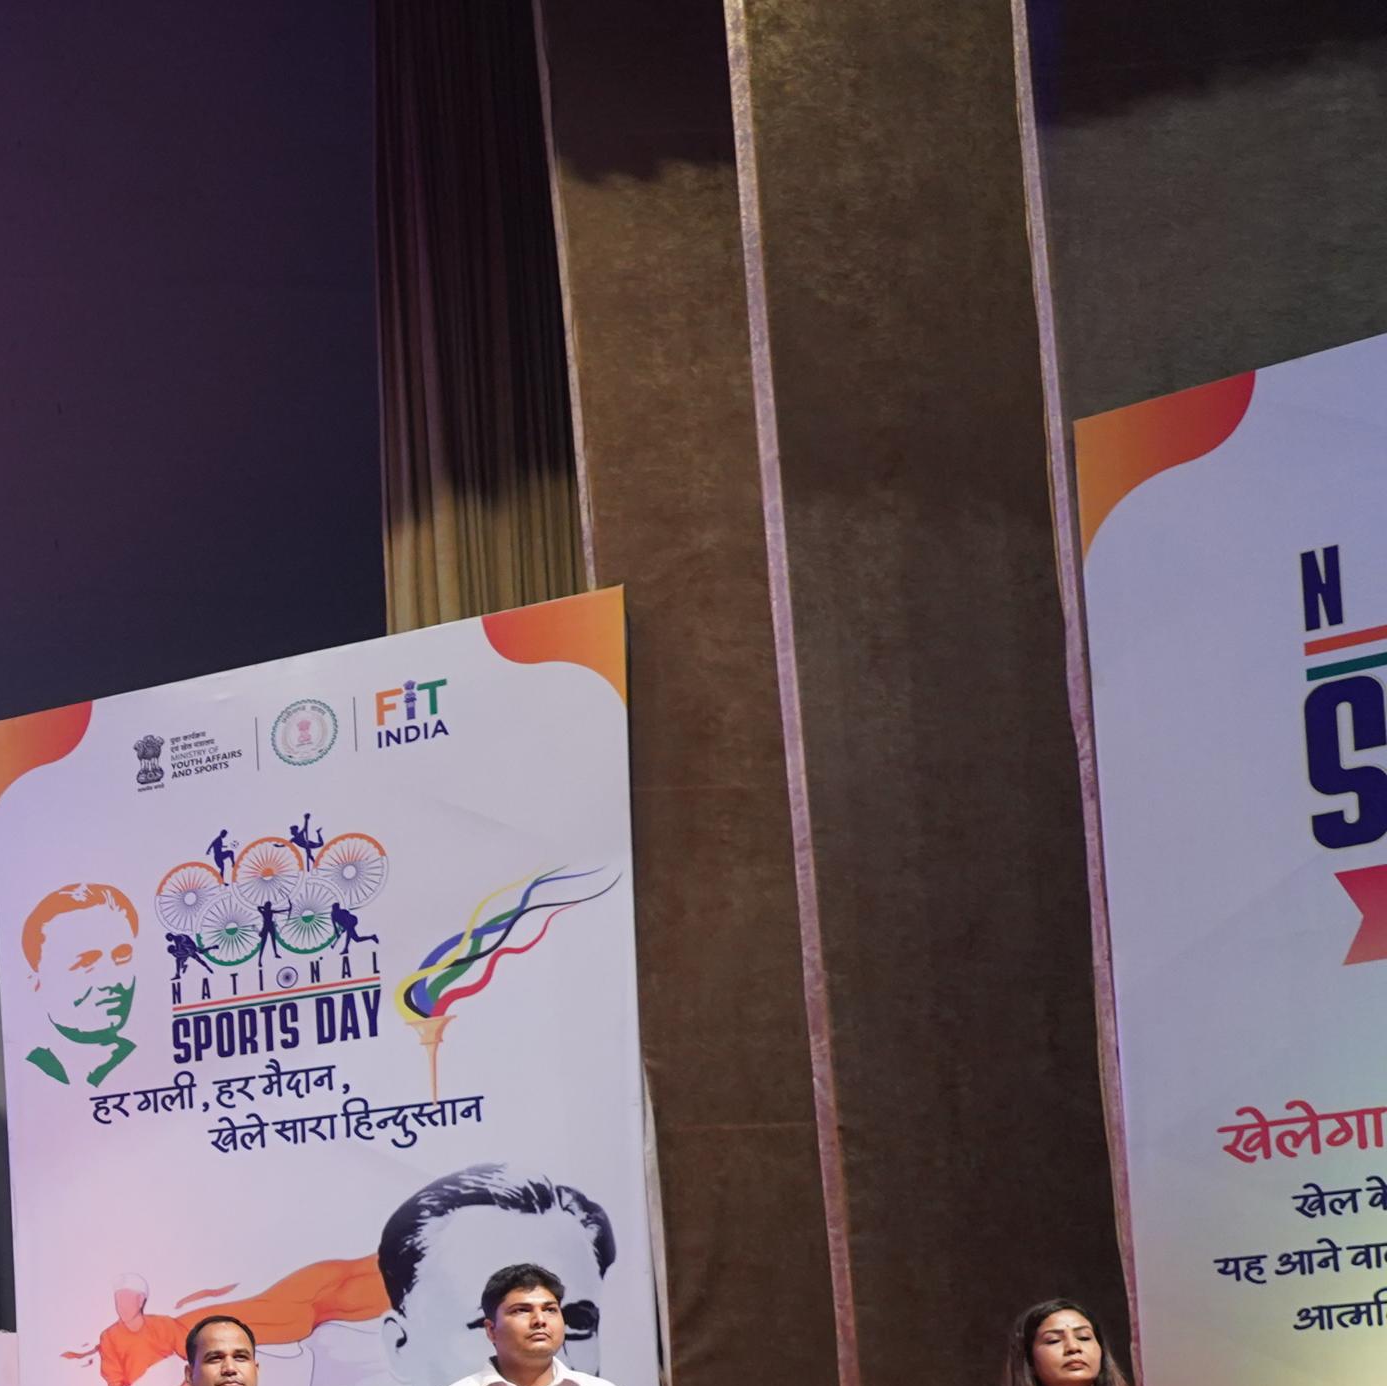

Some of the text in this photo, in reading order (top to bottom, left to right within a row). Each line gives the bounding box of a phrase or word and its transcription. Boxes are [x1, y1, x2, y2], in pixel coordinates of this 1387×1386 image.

[377, 719, 450, 749] INDIA
[171, 746, 218, 762] MINISTRY OF
[171, 749, 242, 770] YOUTH AFFAIRS
[172, 761, 229, 779] AND SPORTS
[172, 988, 382, 1064] SPORTS DAY
[90, 1093, 131, 1125] हर
[213, 1076, 256, 1109] हर
[208, 1096, 484, 1153] खेले सारा हिन्दुस्तान
[1292, 1183, 1362, 1218] खेल
[1214, 1255, 1268, 1284] यह
[1275, 1238, 1342, 1275] आने
